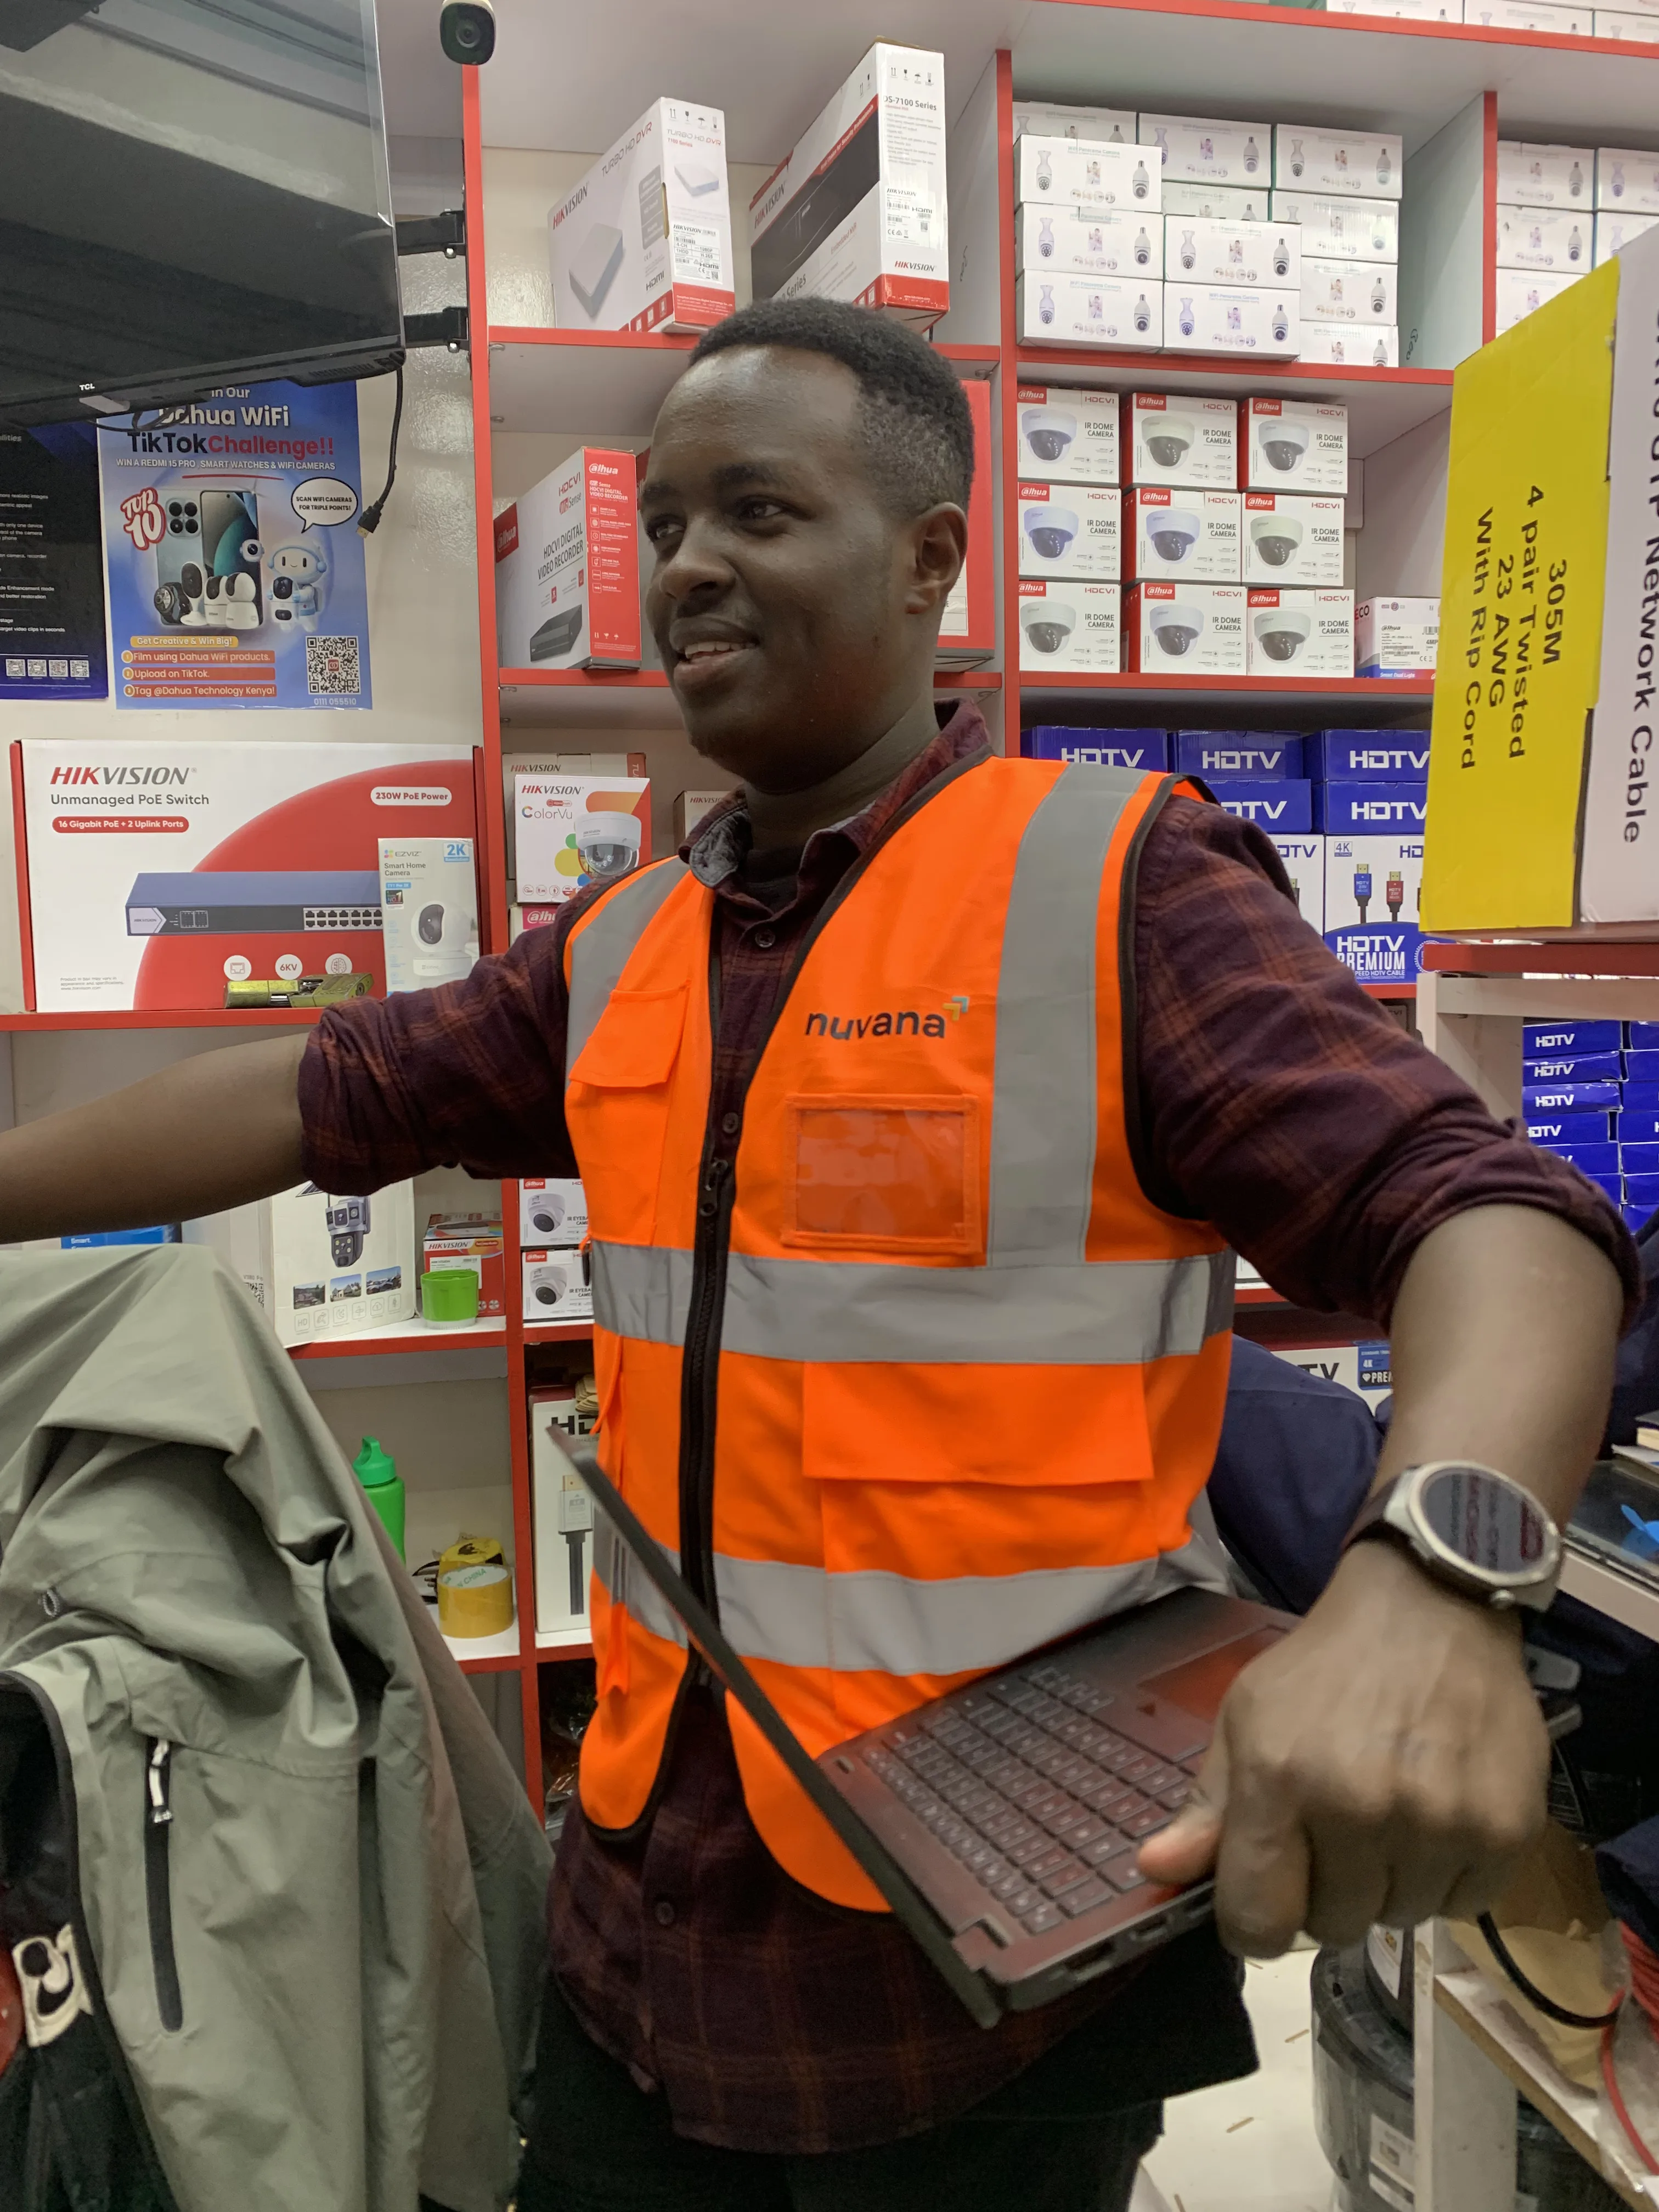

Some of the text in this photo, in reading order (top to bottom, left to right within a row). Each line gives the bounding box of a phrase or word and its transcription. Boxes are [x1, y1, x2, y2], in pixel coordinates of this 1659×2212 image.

[915, 100, 938, 111] Series
[667, 128, 722, 146] TURBO HD DVR
[601, 121, 653, 177] TURBO HD DVR
[887, 188, 917, 197] HIKVISION
[552, 184, 589, 230] HIKVISION
[754, 182, 786, 229] HIKVISION
[673, 224, 702, 234] HIKVISION
[894, 261, 935, 272] HIKVISION
[786, 273, 807, 302] Series
[226, 387, 251, 398] Our
[1085, 396, 1115, 404] HDCVI
[240, 404, 289, 427] WiFi
[1317, 408, 1344, 416] HDCVI
[1093, 422, 1114, 431] DOME
[1324, 434, 1344, 442] DOME
[1319, 441, 1344, 449] CAMERA
[230, 461, 269, 469] WATCHES
[277, 461, 295, 470] WIFI
[296, 462, 336, 471] CAMERAS
[558, 471, 581, 496] HDCVI
[604, 493, 628, 501] RECORDER
[1208, 496, 1237, 505] HDCVI
[1216, 522, 1237, 531] DOME
[543, 522, 583, 560] HDCVI DIGITAL
[538, 539, 584, 580] VIDEO RECORDER
[1543, 558, 1568, 665] 305M
[1093, 613, 1115, 622] DOME
[1220, 616, 1242, 624] DOME
[1509, 484, 1544, 759] 4 pair Twisted
[1088, 620, 1115, 629] CAMERA
[1215, 623, 1242, 631] CAMERA
[1488, 554, 1514, 708] 23 AWG
[137, 636, 233, 647] Get Creative & Win Big!
[1461, 506, 1494, 770] With Rip Cord
[133, 652, 270, 663] Film using Dahua WiFi products.
[134, 669, 210, 680] Upload on TikTok.
[135, 686, 275, 697] Tag @Dahua Technology Kenya!
[314, 697, 357, 706] 0111 055510
[1061, 748, 1145, 769] HDTV
[1202, 751, 1282, 770] HDTV
[1350, 750, 1430, 769] HDTV
[510, 764, 561, 772] HIKVISION
[50, 766, 190, 785] HIKVISION
[1623, 724, 1653, 844] Cable
[521, 785, 582, 795] HIKVISION
[50, 794, 210, 807] Unmanaged PoE Switch
[375, 792, 401, 800] 230W
[421, 792, 448, 800] Power
[521, 805, 573, 820] ColorVu
[69, 820, 101, 829] Gigabit
[135, 820, 161, 829] Uplink
[446, 843, 466, 856] 2K
[1335, 842, 1350, 851] 4K
[1336, 935, 1406, 952] HDTV
[1336, 951, 1406, 971] PREMIUM
[280, 963, 298, 971] 6KV
[804, 1011, 946, 1040] nuvana
[1536, 1033, 1575, 1048] HDTV
[1534, 1063, 1575, 1078] HDTV
[1535, 1094, 1575, 1108] HDTV
[428, 1242, 469, 1250] HIKVISION
